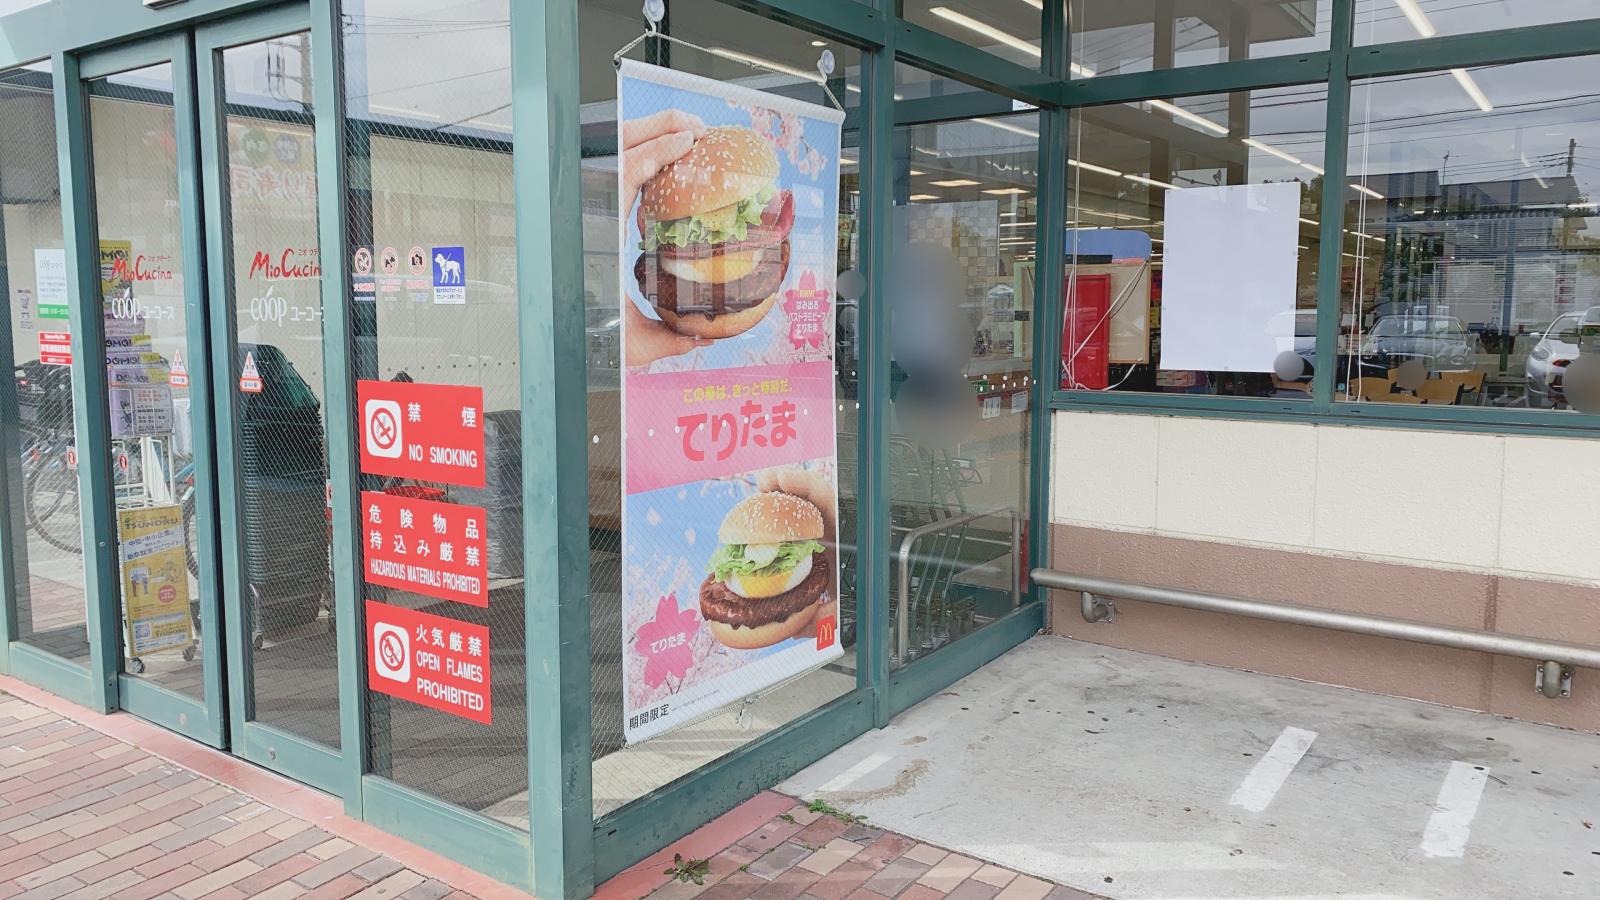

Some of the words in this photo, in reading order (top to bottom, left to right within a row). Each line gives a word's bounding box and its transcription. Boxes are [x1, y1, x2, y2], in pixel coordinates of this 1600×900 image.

[290, 306, 325, 322] ユーコー
[408, 402, 477, 428] 禁煙
[678, 400, 797, 461] てりたま
[408, 444, 423, 462] NO
[430, 446, 478, 468] SMOKING
[369, 503, 480, 541] 危険物品
[369, 530, 481, 567] 持込み厳禁
[370, 558, 406, 581] HAZARDOUS
[407, 565, 441, 588] MATERIALS
[441, 571, 481, 596] PROHIBITED
[415, 623, 482, 657] 火気厳禁
[650, 632, 687, 654] てりたま
[416, 650, 441, 672] OPEN
[446, 658, 483, 684] FLAMES
[416, 677, 484, 712] PROHIBITED
[629, 703, 670, 731] 期間限定
